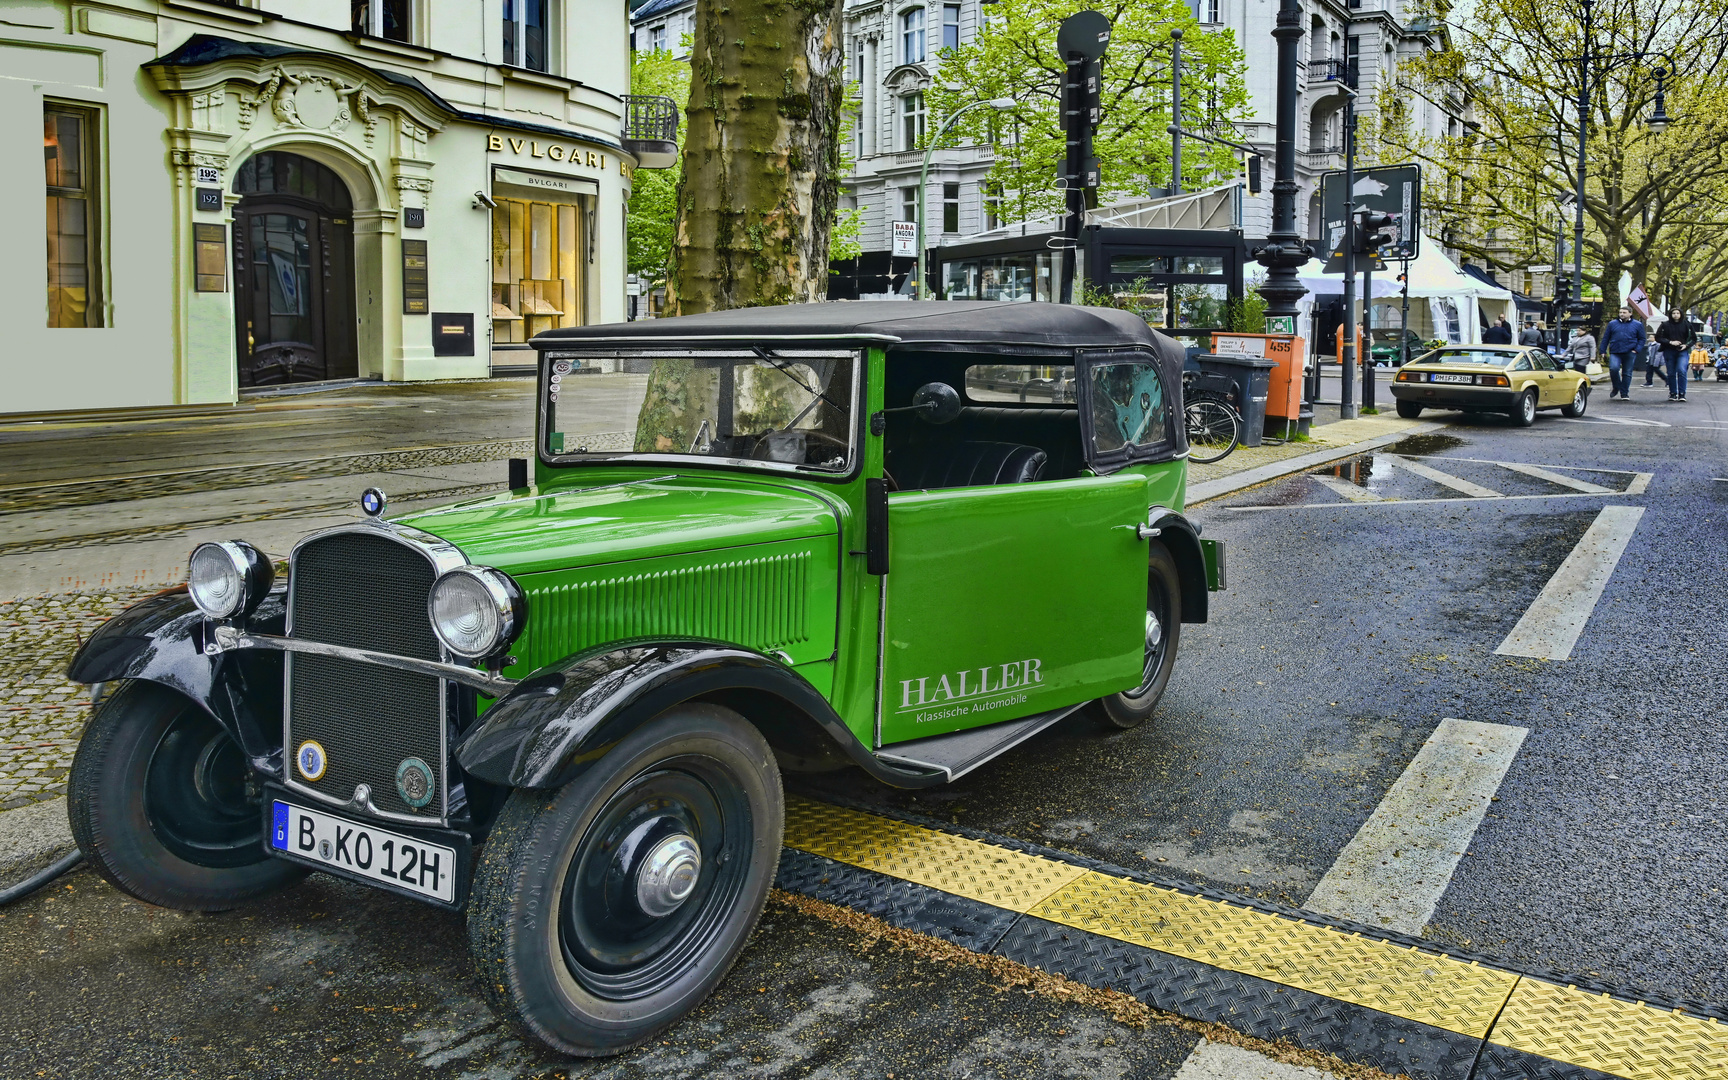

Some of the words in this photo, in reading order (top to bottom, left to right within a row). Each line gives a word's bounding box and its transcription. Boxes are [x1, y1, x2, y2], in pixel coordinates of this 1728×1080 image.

[487, 134, 607, 170] BVLGARI
[200, 169, 217, 178] 192
[528, 177, 568, 189] BVLGARI
[202, 194, 218, 204] 192
[409, 213, 422, 221] 190
[895, 223, 915, 231] BABA
[1270, 341, 1291, 352] 455
[898, 658, 1044, 708] HALLER
[916, 706, 969, 723] Klassische
[971, 694, 1027, 713] Automobile
[278, 830, 284, 841] D
[298, 814, 316, 852] B
[335, 825, 373, 870] KO
[380, 839, 440, 891] 12H
